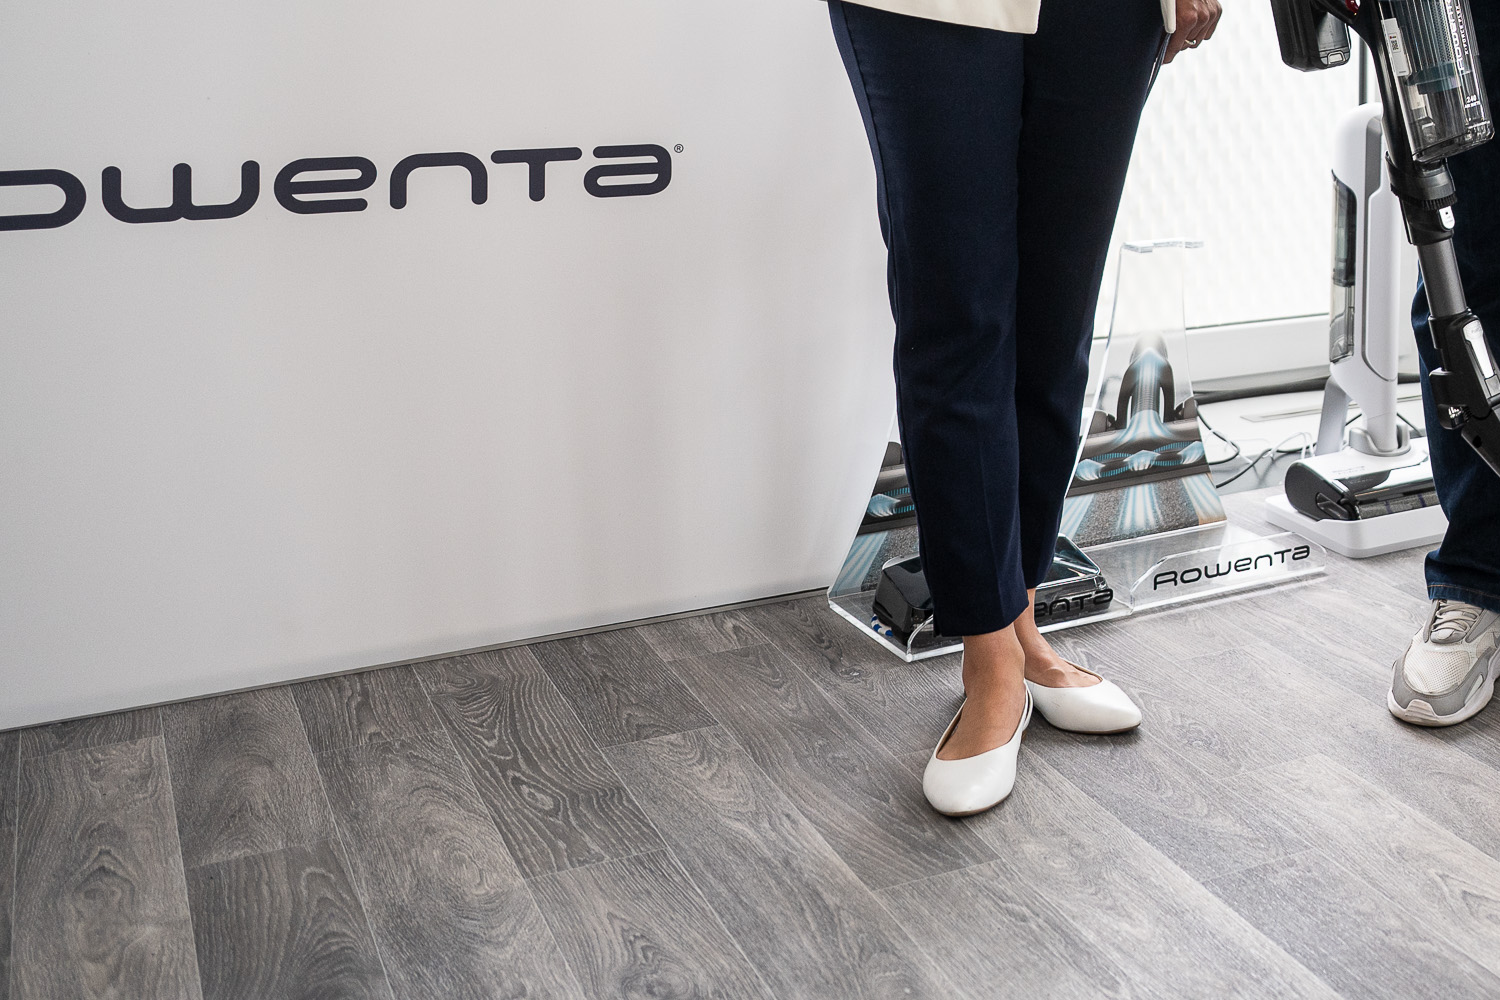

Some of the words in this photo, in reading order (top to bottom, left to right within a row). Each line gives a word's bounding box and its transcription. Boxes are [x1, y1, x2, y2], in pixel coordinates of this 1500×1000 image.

[0, 143, 673, 232] owenta
[1152, 544, 1311, 591] Rowenta
[1034, 588, 1115, 618] enta
